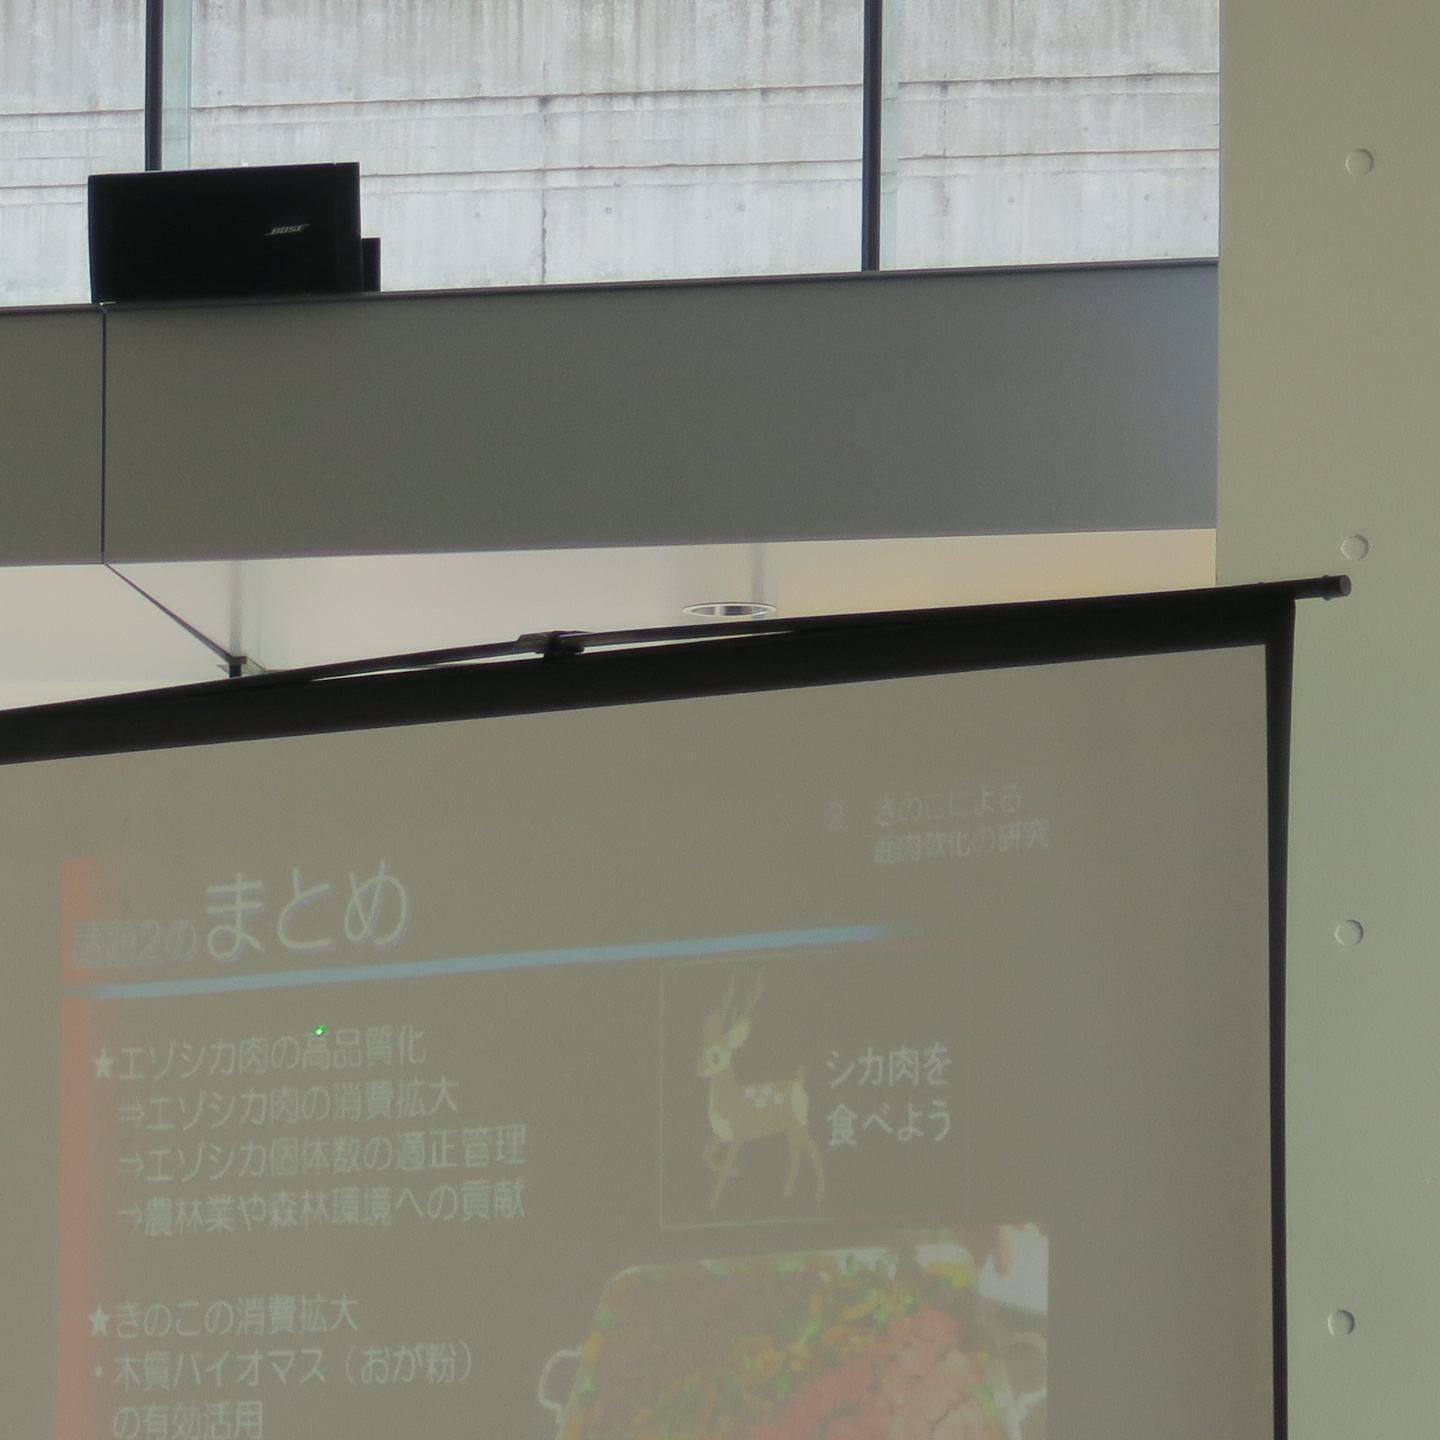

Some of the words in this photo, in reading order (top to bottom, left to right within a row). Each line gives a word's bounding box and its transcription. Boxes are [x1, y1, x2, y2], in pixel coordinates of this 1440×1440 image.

[825, 1043, 953, 1088] シカ肉を
[825, 1099, 953, 1147] 食べよう
